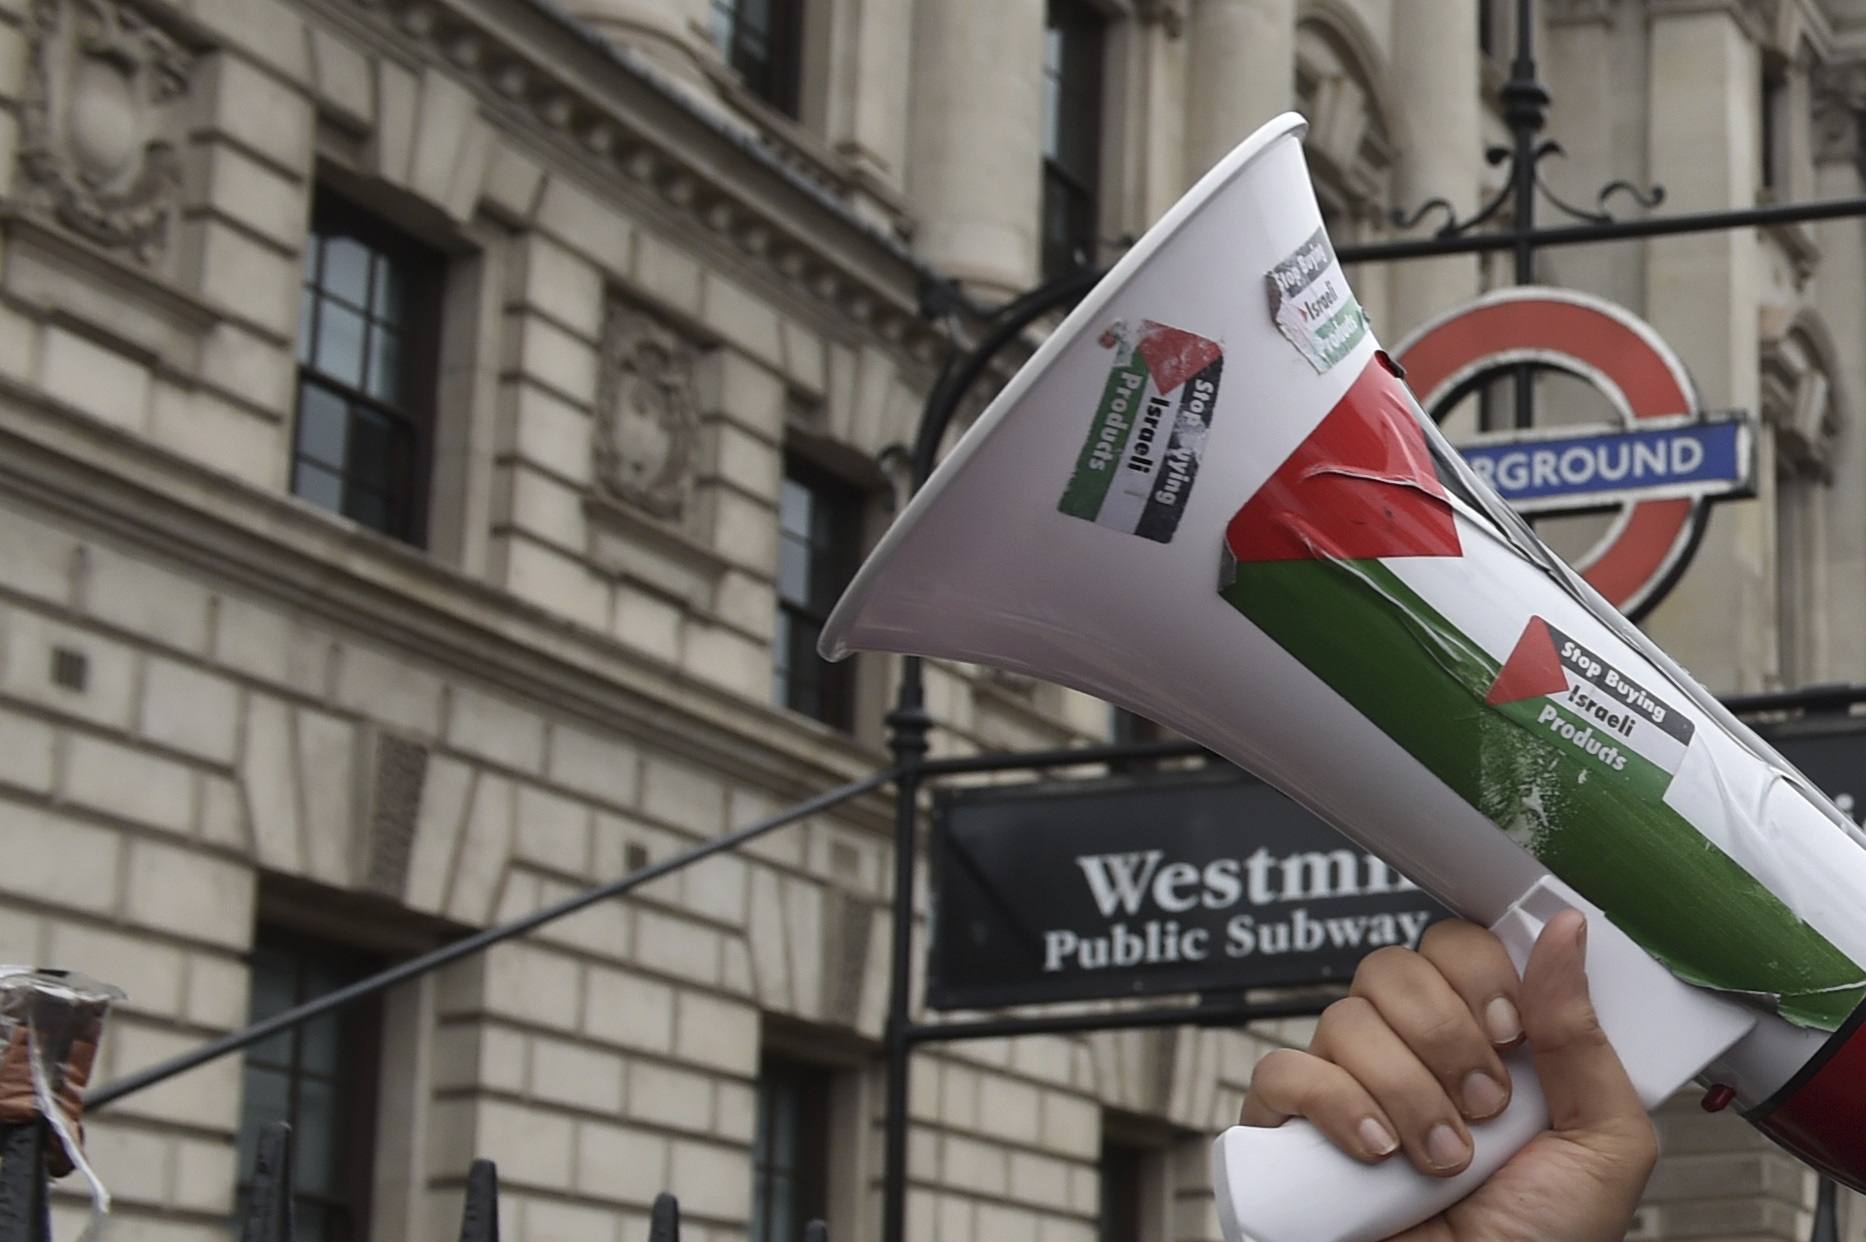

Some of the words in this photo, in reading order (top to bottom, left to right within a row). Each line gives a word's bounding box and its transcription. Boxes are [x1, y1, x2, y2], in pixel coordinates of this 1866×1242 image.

[1304, 280, 1339, 320] Israeli
[1088, 372, 1143, 471] Products
[1127, 396, 1170, 473] Israeli
[1182, 379, 1215, 426] Stop
[1561, 641, 1602, 678] Stop
[1604, 666, 1666, 723] Buying
[1567, 685, 1638, 738] Israeli
[1537, 704, 1628, 771] Products
[1076, 846, 1421, 917] Westmi
[1042, 919, 1209, 972] Public
[1225, 908, 1431, 958] Subway
